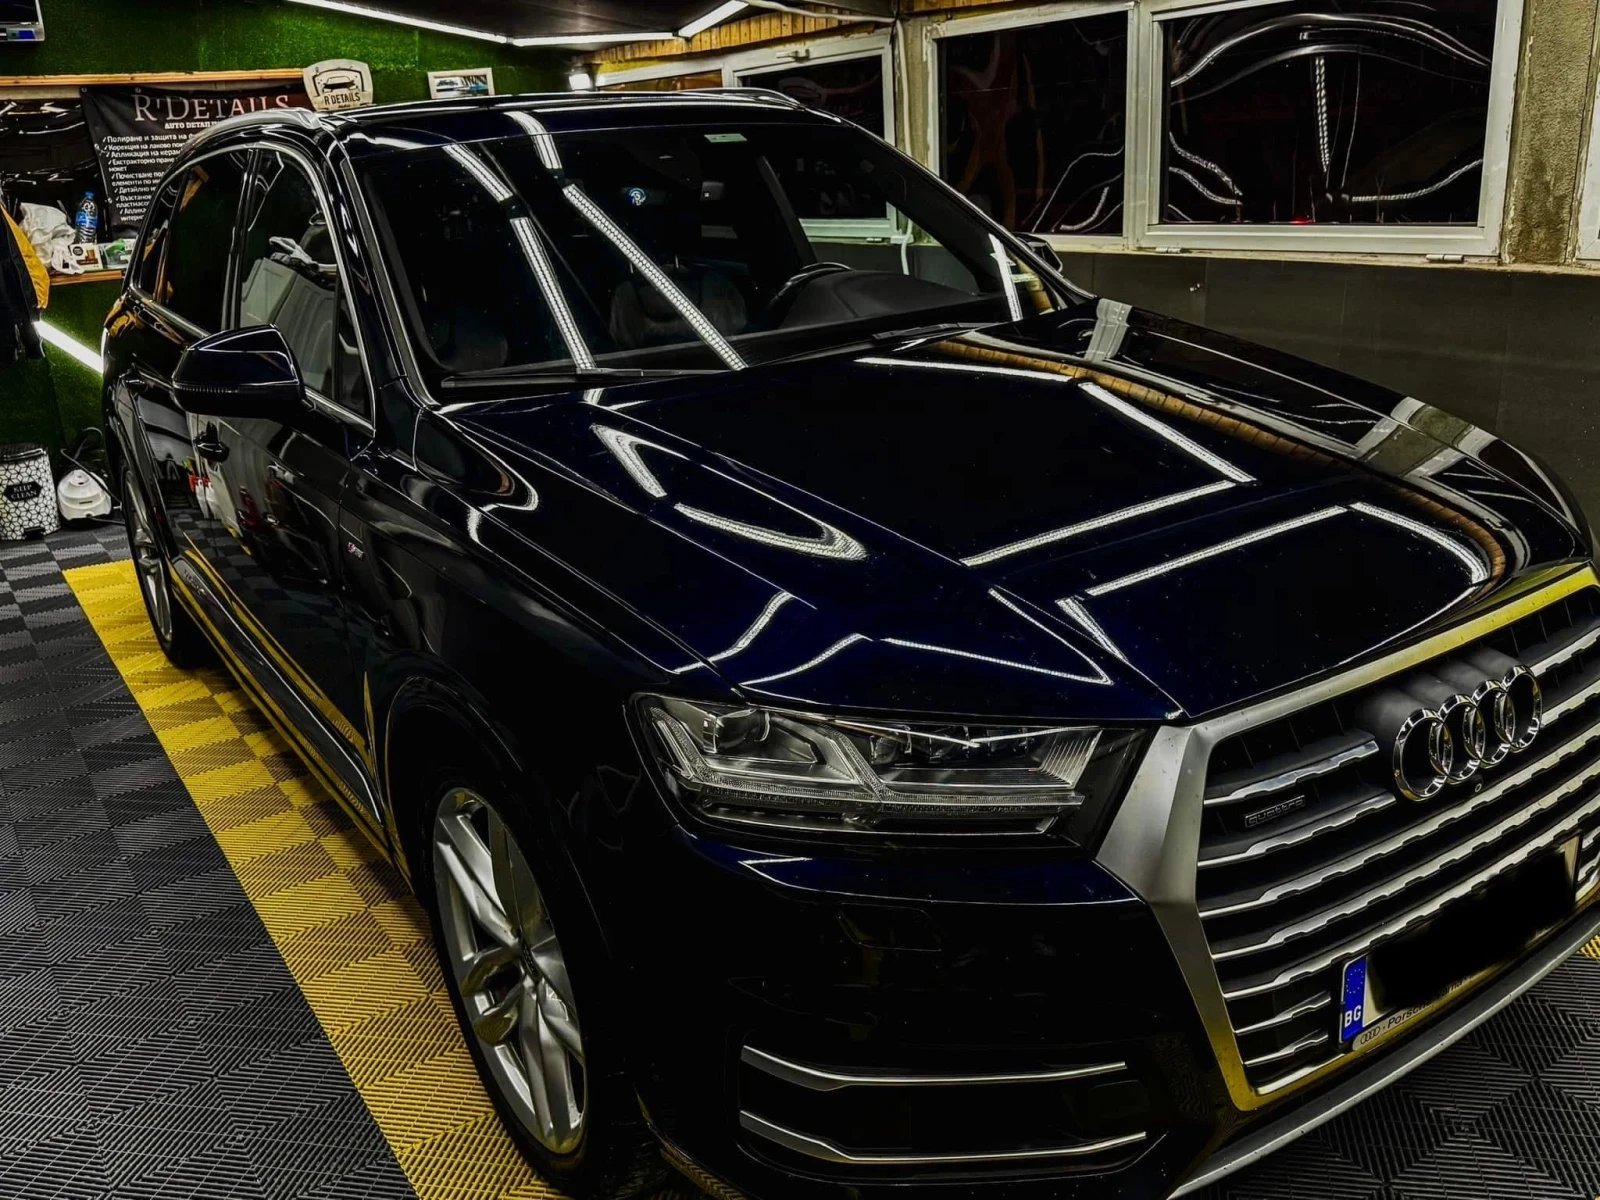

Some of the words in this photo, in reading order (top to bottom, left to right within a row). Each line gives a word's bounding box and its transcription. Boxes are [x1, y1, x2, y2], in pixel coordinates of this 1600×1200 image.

[323, 92, 361, 106] R'DETAILS
[164, 122, 185, 130] AUTO
[106, 135, 142, 143] Полиране
[151, 134, 177, 142] защита
[108, 144, 140, 152] Корекция
[111, 150, 150, 158] Апликация
[160, 149, 182, 157] керам
[112, 158, 155, 166] Екстракторно
[115, 172, 152, 180] Почистване
[111, 179, 142, 187] елементи
[118, 186, 149, 194] Детайлно
[13, 484, 32, 492] KEEP
[11, 489, 37, 499] CLEAN
[1248, 798, 1304, 825] quattro
[1344, 1005, 1362, 1028] BG
